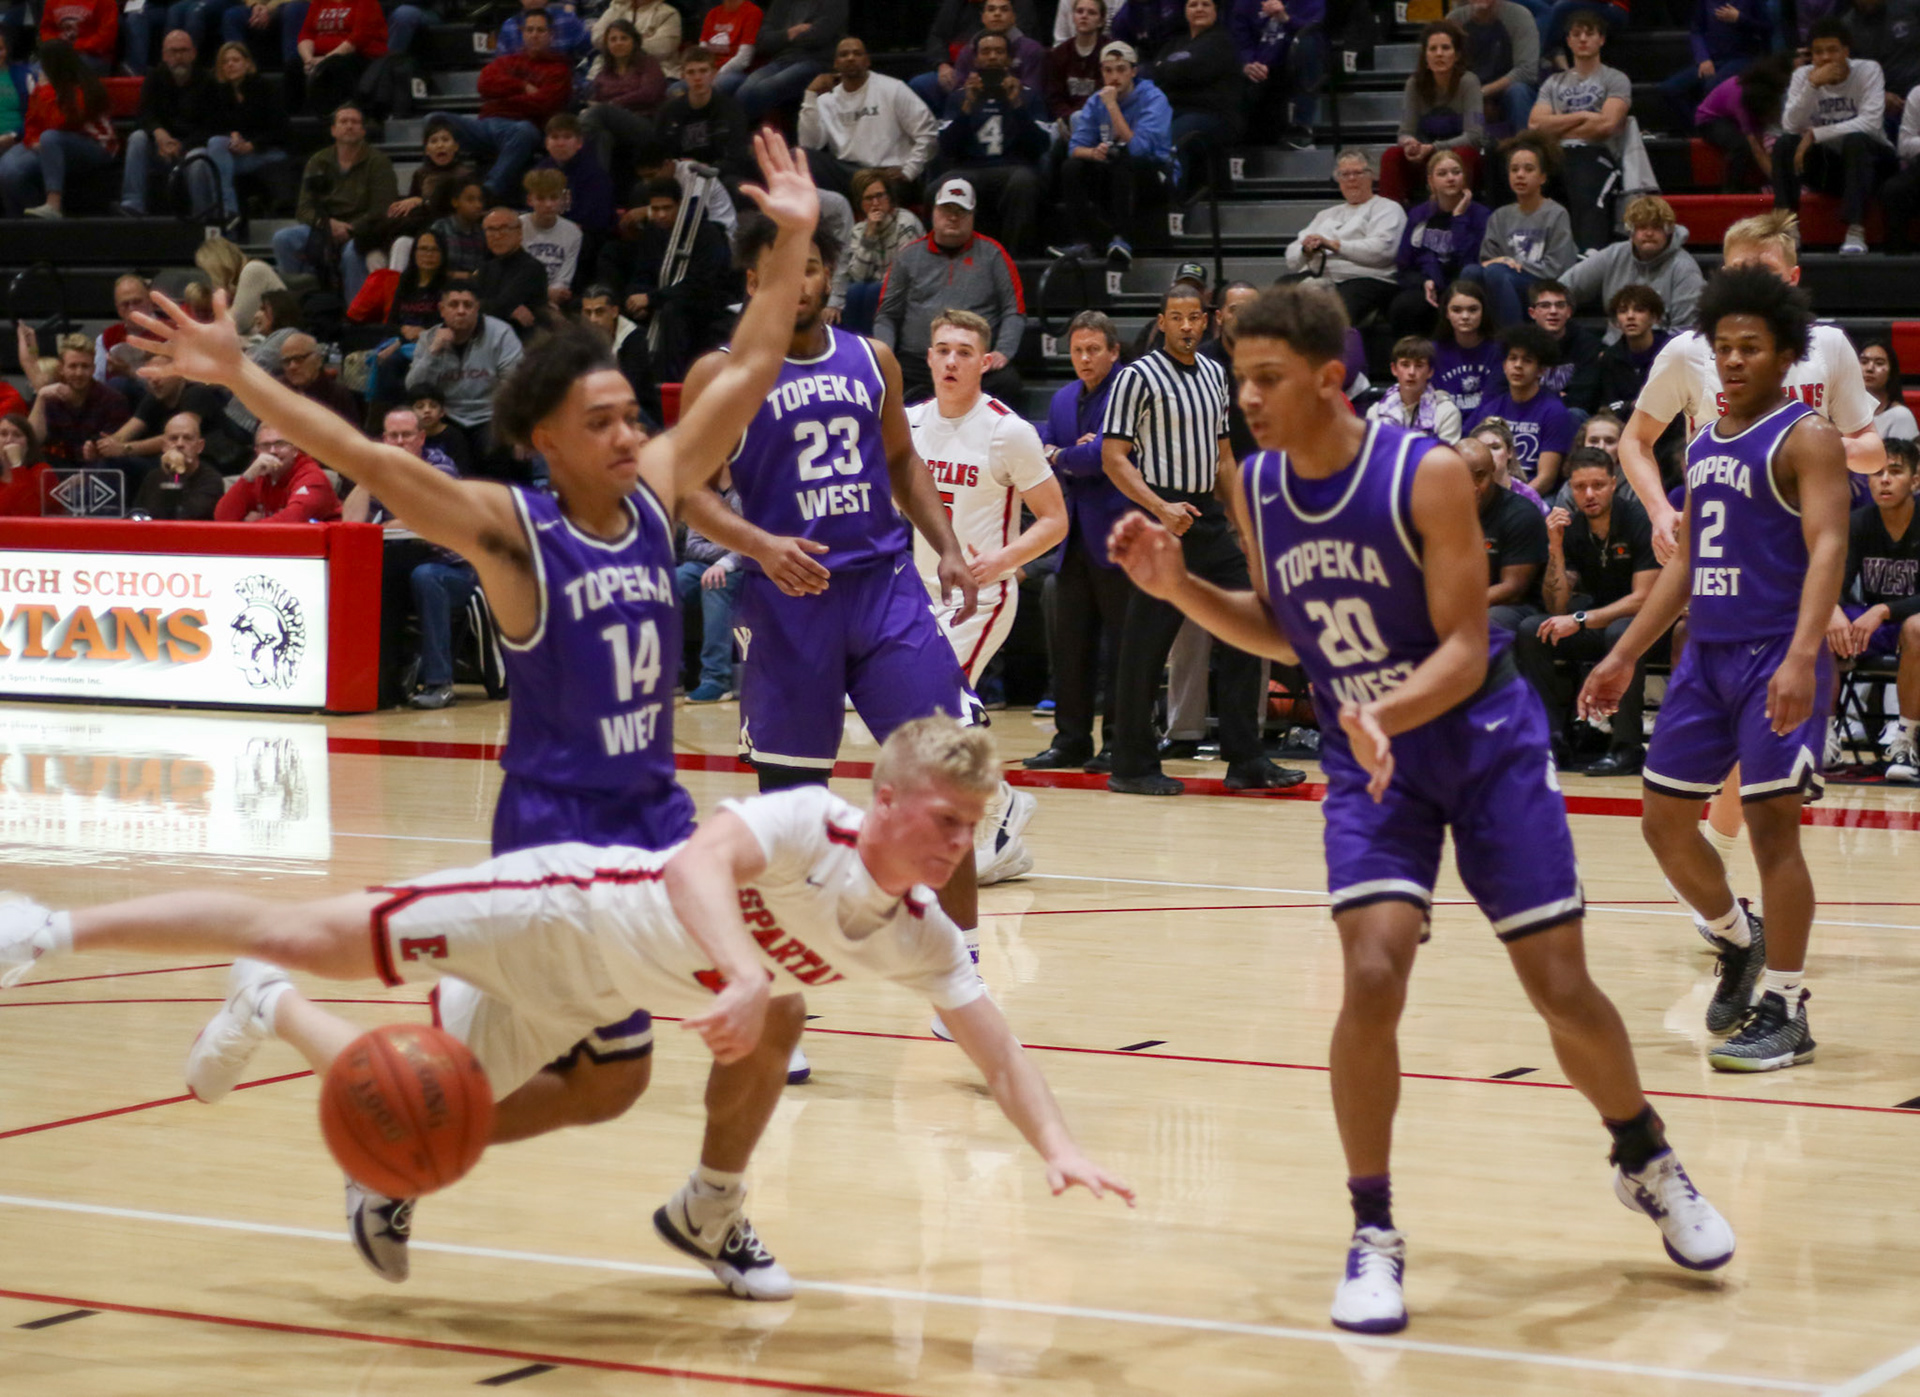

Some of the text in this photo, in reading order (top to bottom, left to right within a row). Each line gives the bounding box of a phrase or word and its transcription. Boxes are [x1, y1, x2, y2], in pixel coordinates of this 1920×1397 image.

[976, 115, 1004, 156] 4
[766, 374, 874, 421] TOPEKA
[793, 416, 865, 482] 23
[796, 482, 872, 521] WEST
[1698, 500, 1726, 558] 2
[73, 570, 212, 598] SCHOOL
[564, 565, 675, 622] TOPEKA
[1275, 539, 1391, 596] TOPEKA
[1863, 557, 1919, 596] WEST
[601, 619, 662, 703] 14
[1304, 597, 1390, 668] 20
